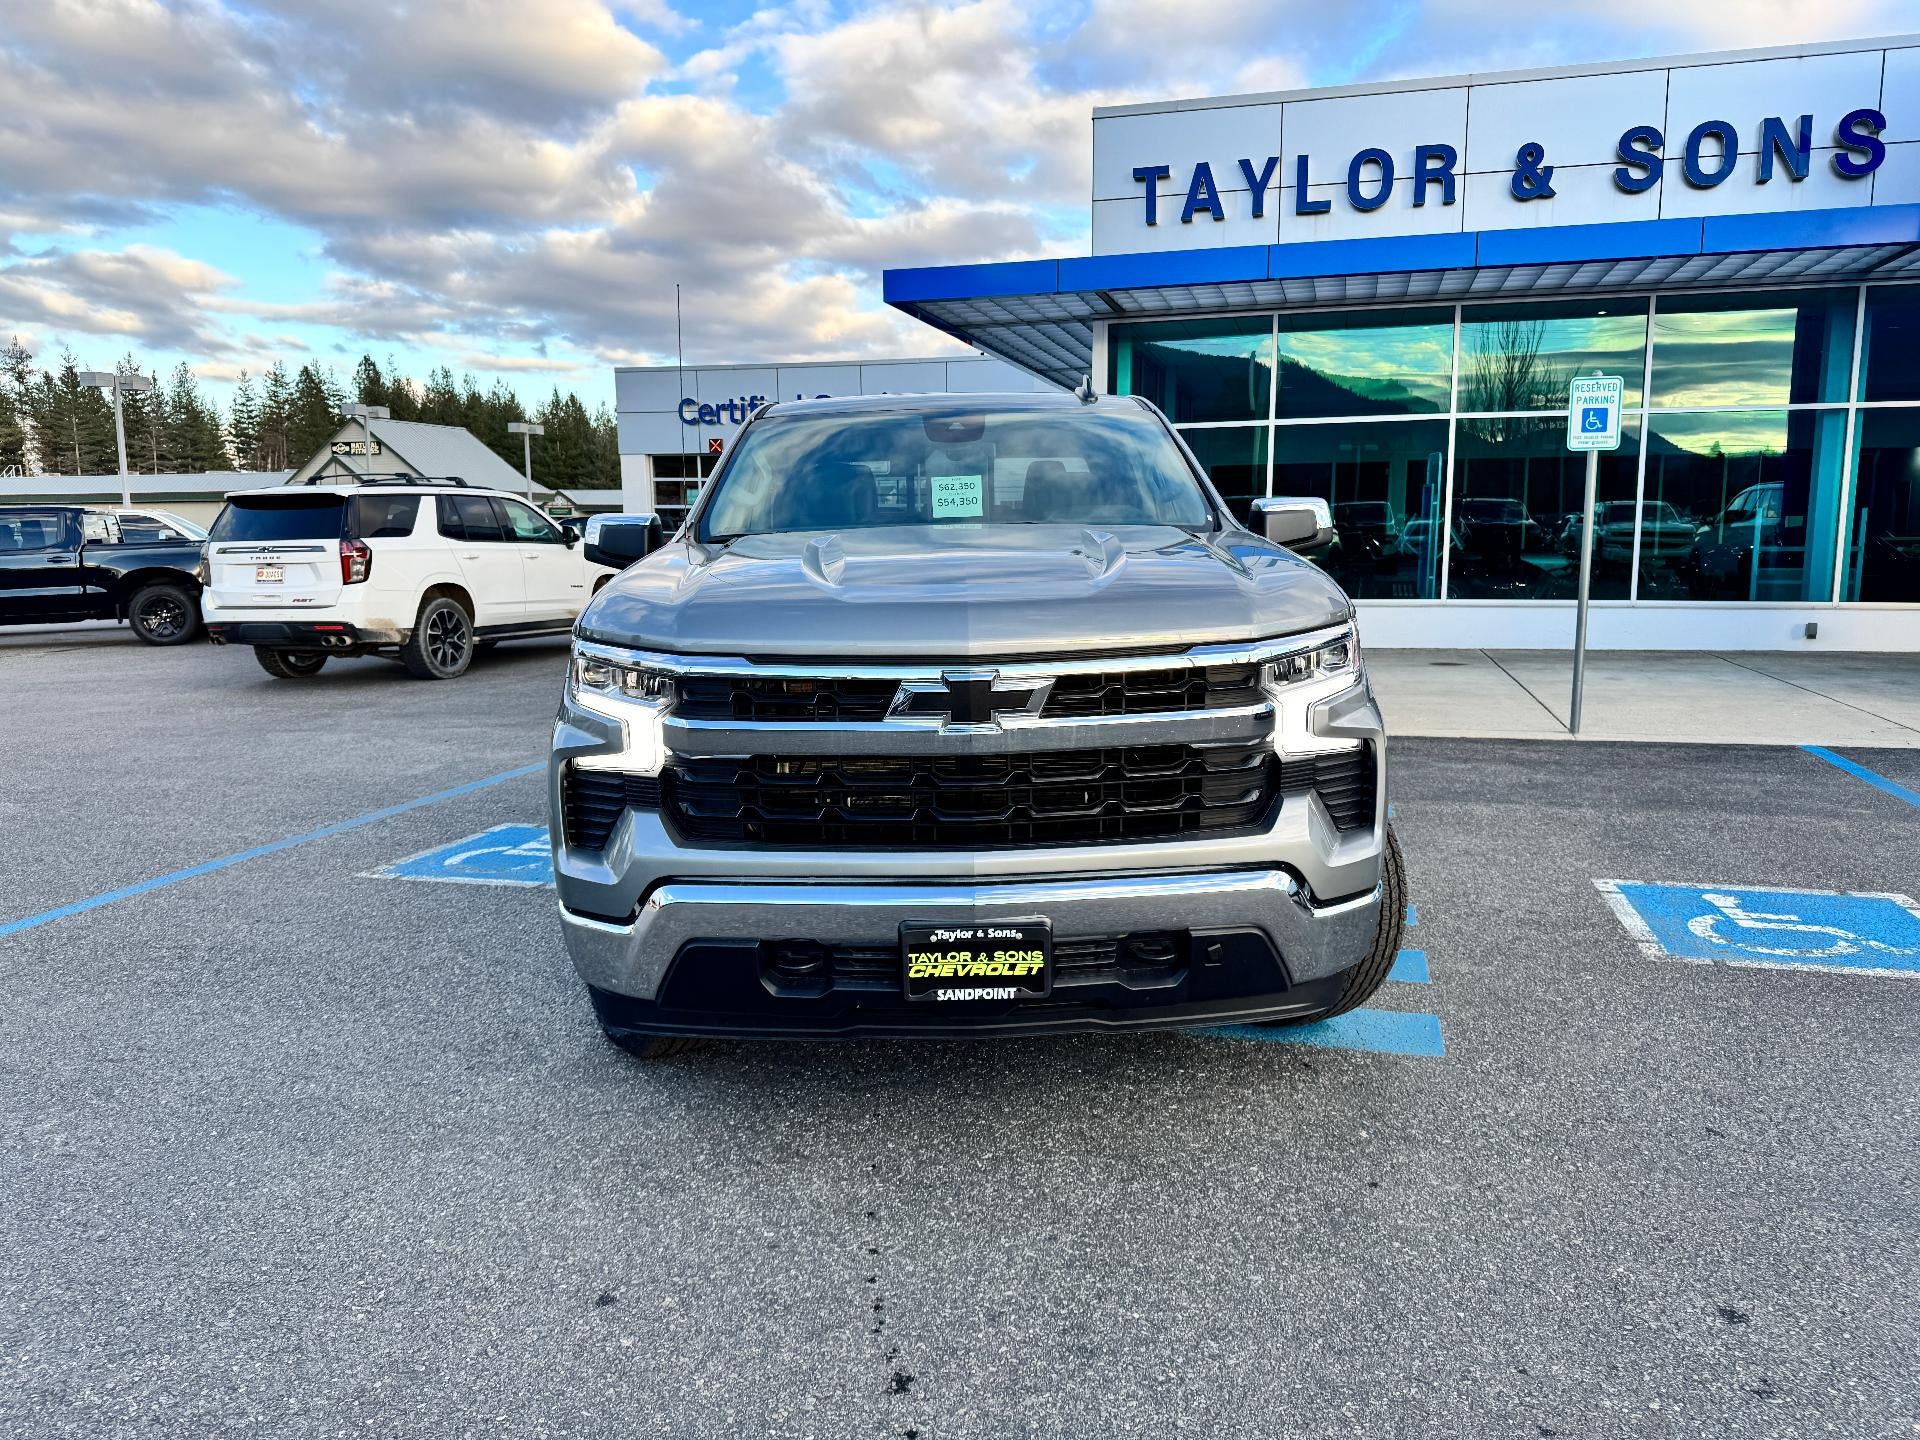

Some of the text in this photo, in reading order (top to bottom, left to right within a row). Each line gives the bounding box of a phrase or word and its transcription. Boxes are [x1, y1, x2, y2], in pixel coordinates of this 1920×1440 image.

[1132, 108, 1887, 226] TAYLOR & SONS
[1575, 383, 1617, 392] RESERVED
[1577, 395, 1615, 404] PARKING
[937, 496, 978, 507] $54,350
[935, 928, 1017, 942] Taylor & Sons
[908, 950, 1044, 963] TAYLOR & SONS
[908, 963, 1044, 978] CHEVROLET
[937, 987, 1017, 1001] SANDPOINT
